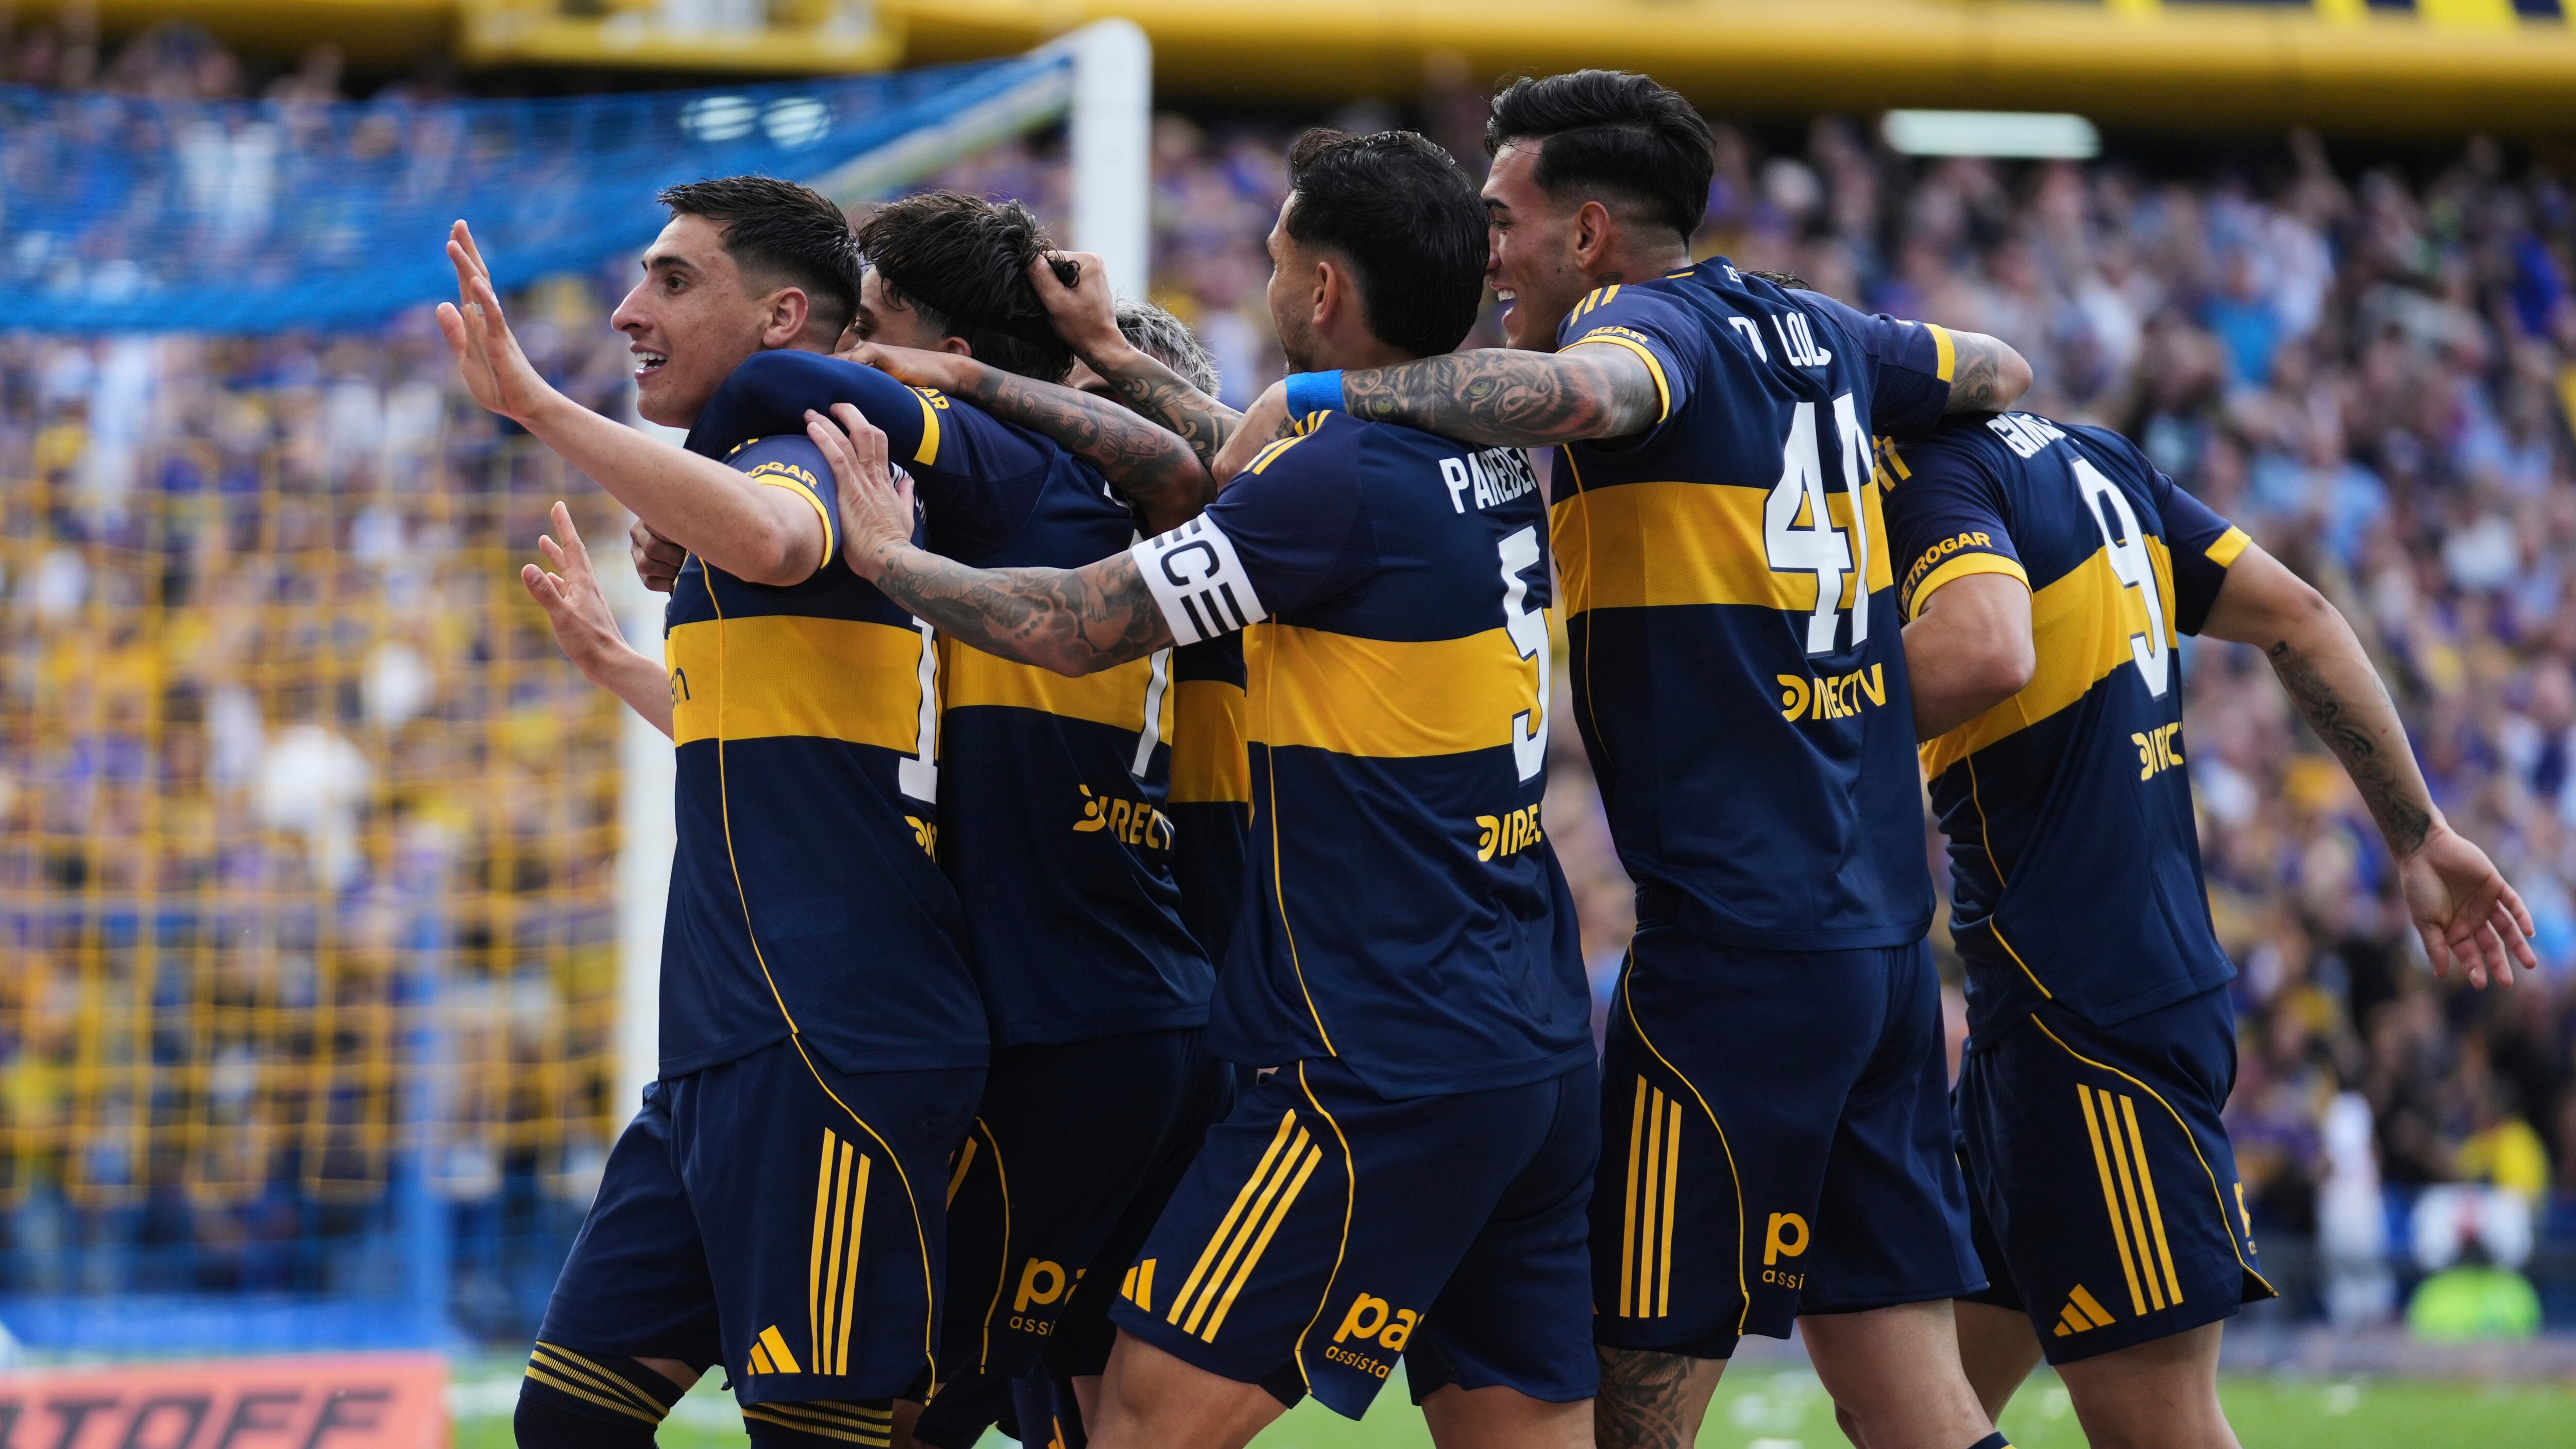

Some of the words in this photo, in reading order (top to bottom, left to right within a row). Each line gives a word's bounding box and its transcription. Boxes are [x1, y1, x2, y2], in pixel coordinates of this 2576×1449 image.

[745, 462, 817, 488] OGAR
[2073, 457, 2168, 697] 9
[1498, 524, 1550, 782] 5
[1333, 1292, 1425, 1352] pa
[0, 1387, 396, 1449] TOFF
